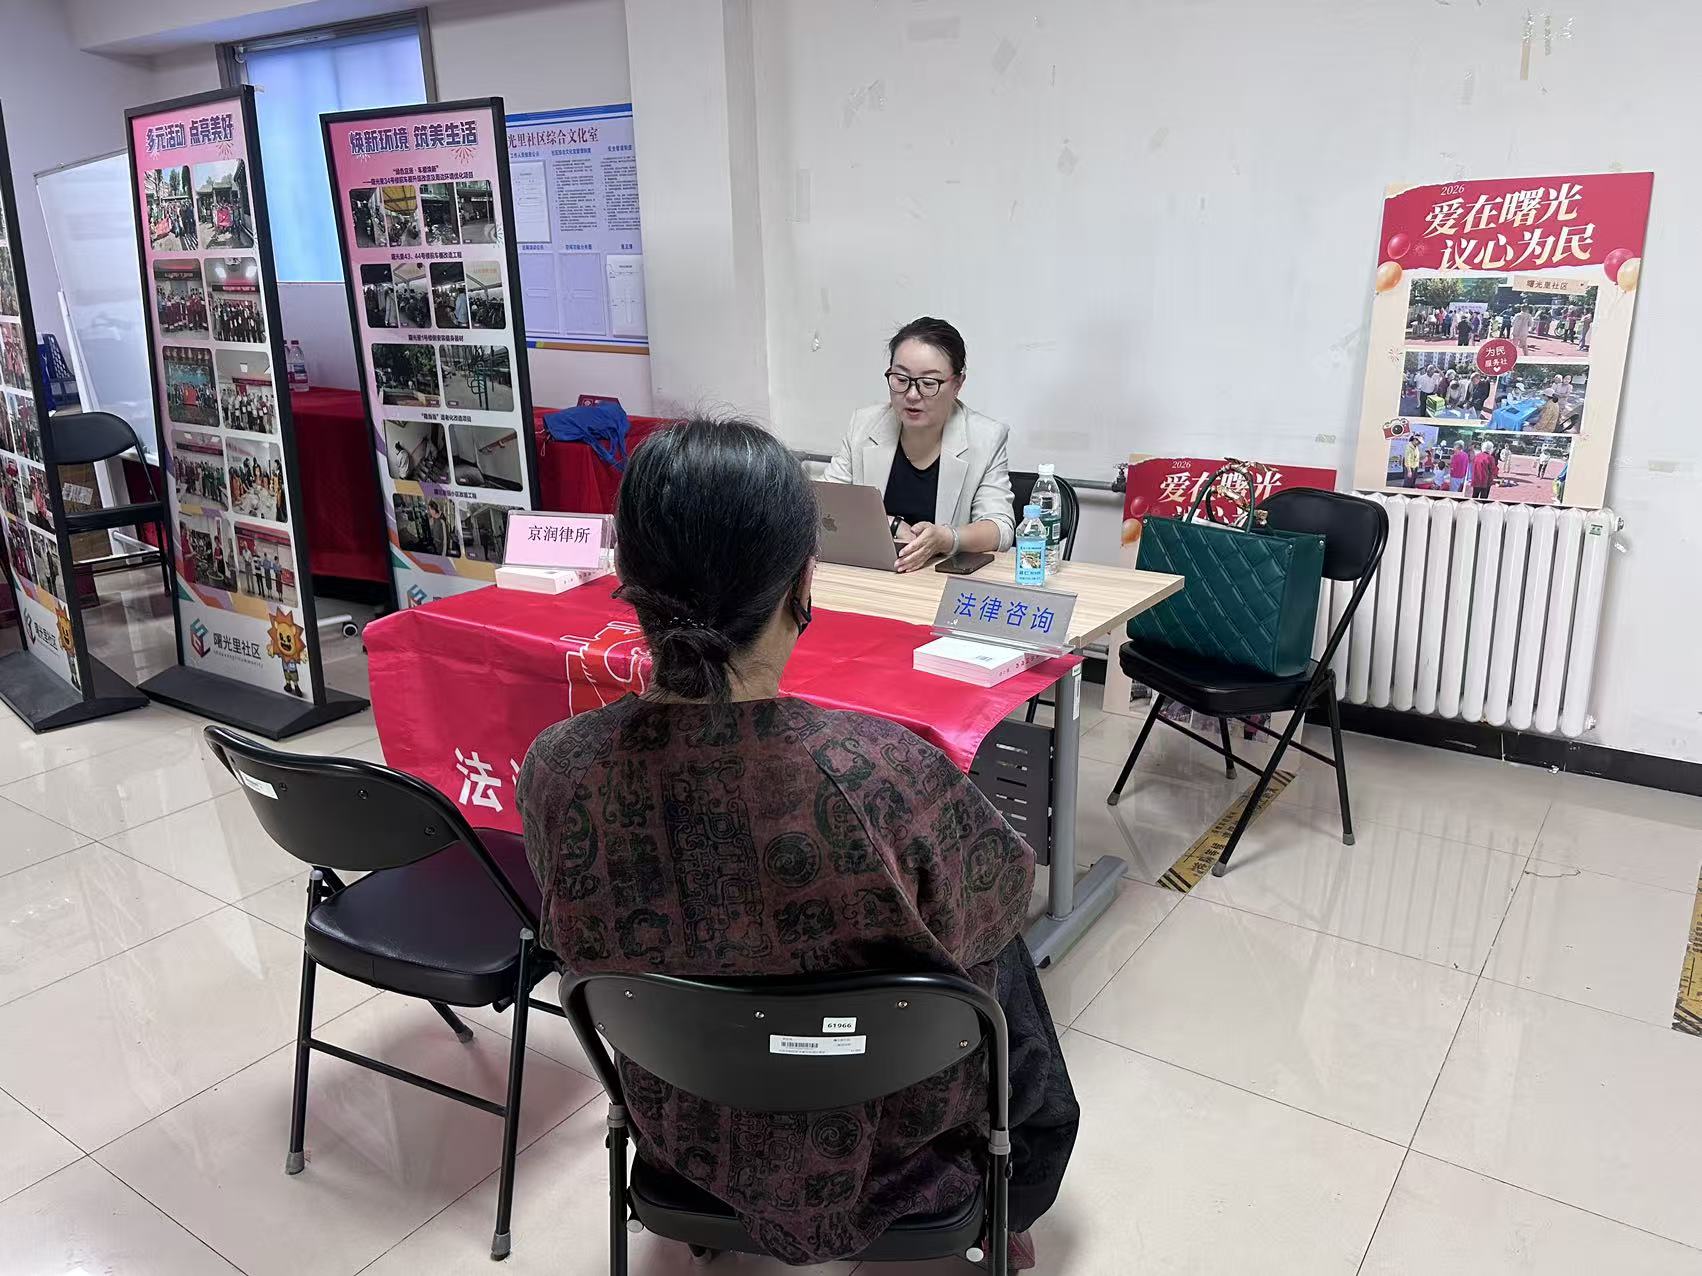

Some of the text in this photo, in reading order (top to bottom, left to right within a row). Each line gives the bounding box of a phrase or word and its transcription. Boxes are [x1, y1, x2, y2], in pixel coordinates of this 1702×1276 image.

[146, 114, 234, 152] 多元活动 点亮美好
[349, 120, 479, 154] 焕新环境 筑美生活
[1441, 184, 1465, 196] 2026
[1422, 182, 1584, 239] 爱在曙光
[1439, 222, 1596, 272] 议心为民
[1526, 279, 1569, 291] 曙光里社区
[1484, 358, 1508, 368] 服务社
[1485, 345, 1506, 358] 为民
[1171, 460, 1191, 469] 2026
[527, 525, 591, 544] 京润律所
[953, 592, 1055, 634] 法律咨询
[213, 632, 262, 660] 曙光里社区
[454, 747, 520, 813] 法
